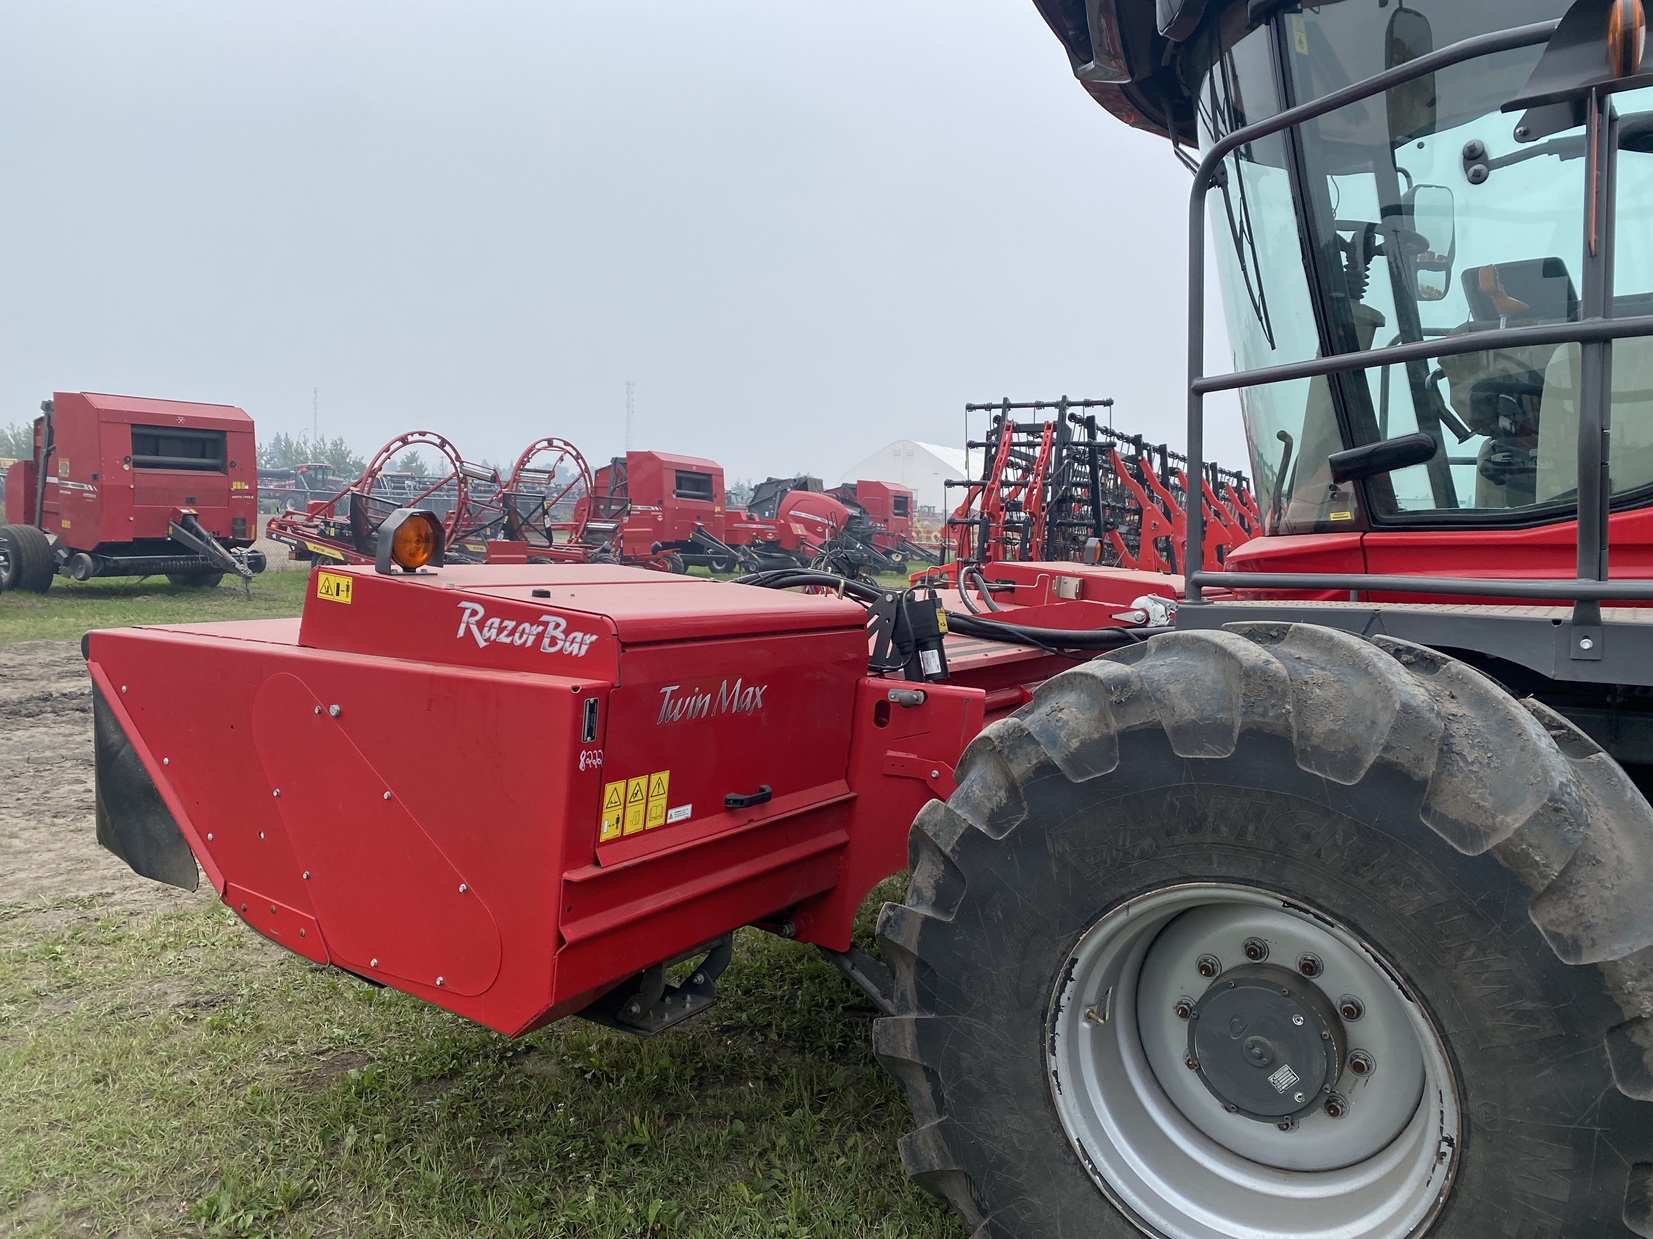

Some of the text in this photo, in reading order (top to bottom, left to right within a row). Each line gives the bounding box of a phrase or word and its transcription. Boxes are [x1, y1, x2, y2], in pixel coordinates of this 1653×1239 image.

[457, 600, 599, 658] RazorBar
[656, 677, 768, 725] Twin Max
[578, 749, 604, 771] 8222
